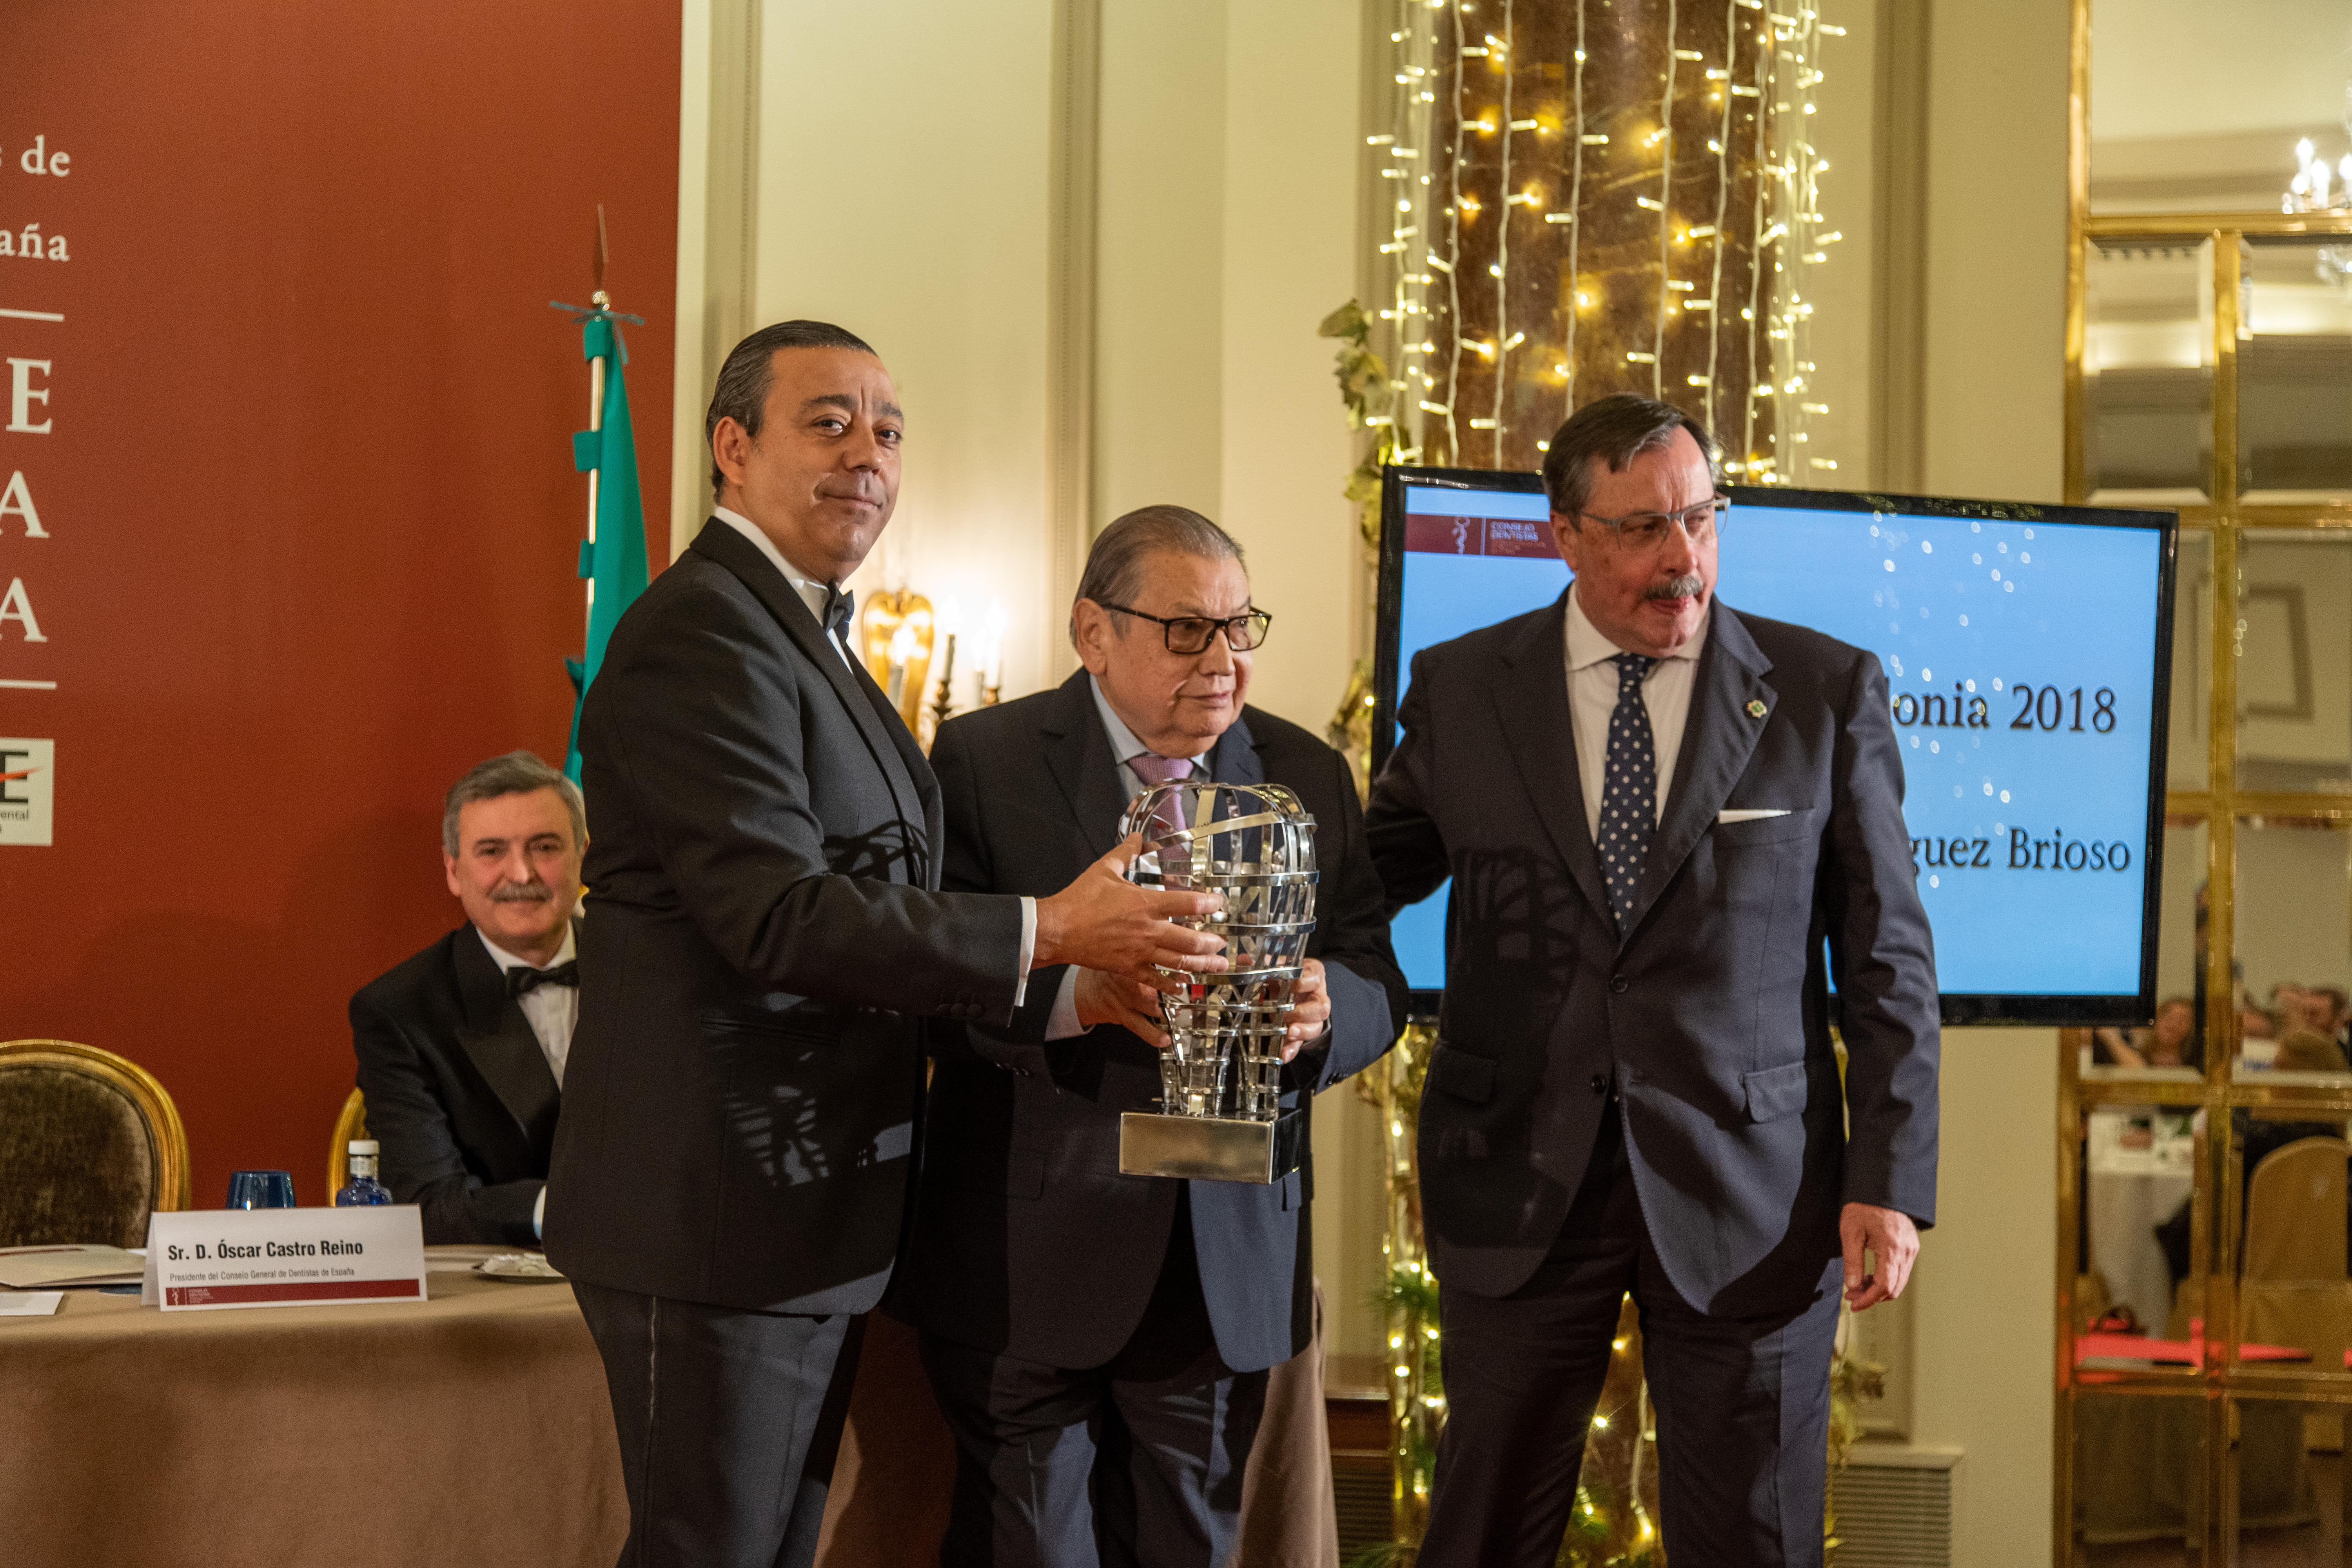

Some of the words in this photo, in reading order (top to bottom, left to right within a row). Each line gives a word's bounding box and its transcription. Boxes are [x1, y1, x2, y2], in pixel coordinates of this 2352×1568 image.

[20, 134, 71, 177] de
[5, 357, 53, 434] E
[1885, 679, 1990, 728] onia
[2009, 684, 2116, 733] 2018
[2007, 827, 2131, 871] Brioso
[168, 1245, 190, 1260] Sr.
[196, 1243, 212, 1259] D.
[218, 1239, 261, 1258] Óscar
[267, 1241, 316, 1257] Castro
[320, 1240, 363, 1256] Reino
[170, 1273, 206, 1281] Presidente
[208, 1272, 219, 1280] del
[221, 1270, 249, 1280] Consejo
[250, 1269, 276, 1279] General
[288, 1269, 319, 1277] Dentistas
[331, 1267, 355, 1276] España
